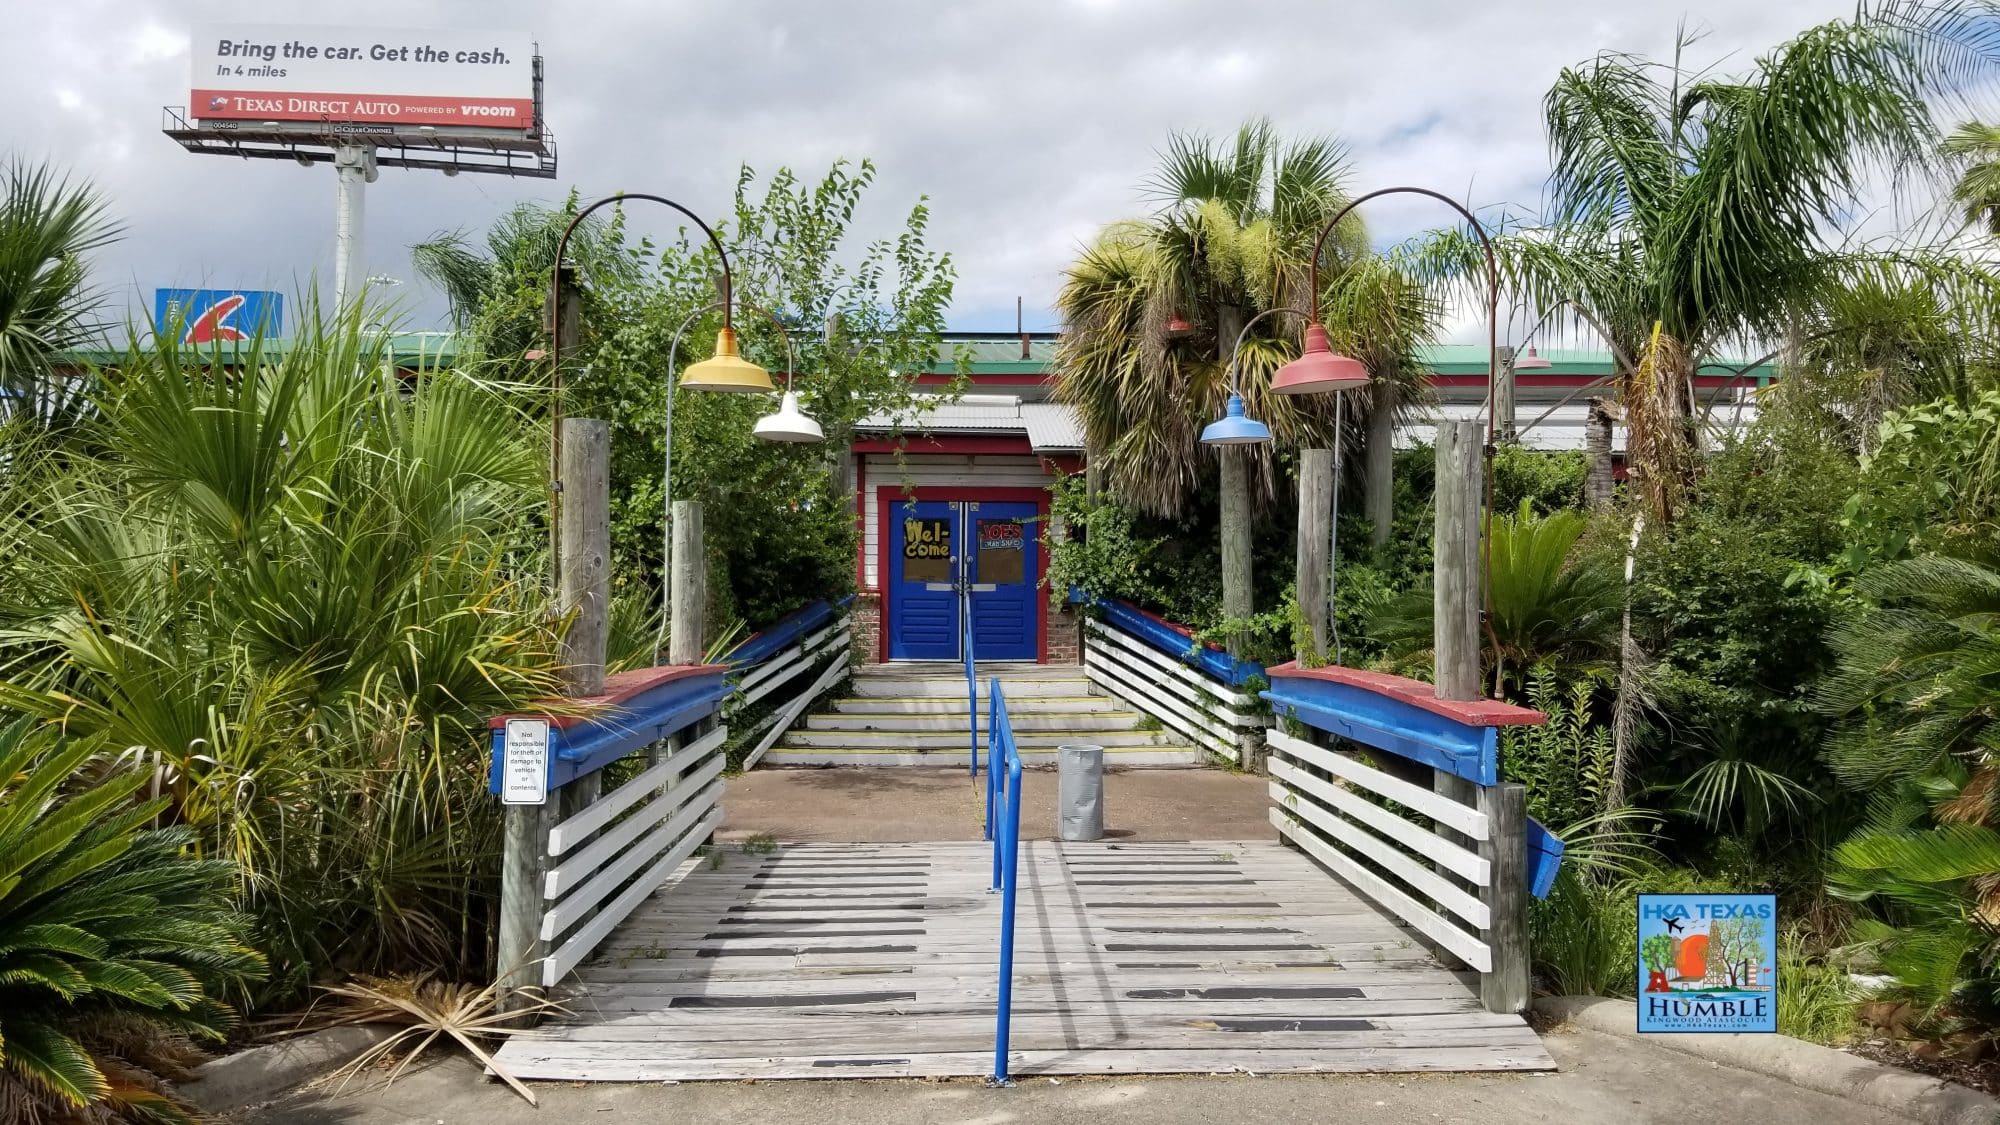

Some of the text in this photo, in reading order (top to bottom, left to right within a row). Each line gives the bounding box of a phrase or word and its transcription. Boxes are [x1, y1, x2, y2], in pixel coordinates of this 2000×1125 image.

[218, 39, 510, 65] Bring the car. Get the cash.
[217, 65, 287, 77] In 4 miles
[234, 97, 283, 112] TEXAS
[288, 98, 349, 114] DIRECT
[354, 100, 400, 116] AUTO
[405, 106, 444, 114] POWERED
[461, 105, 516, 117] vroom
[905, 520, 949, 542] Wel-
